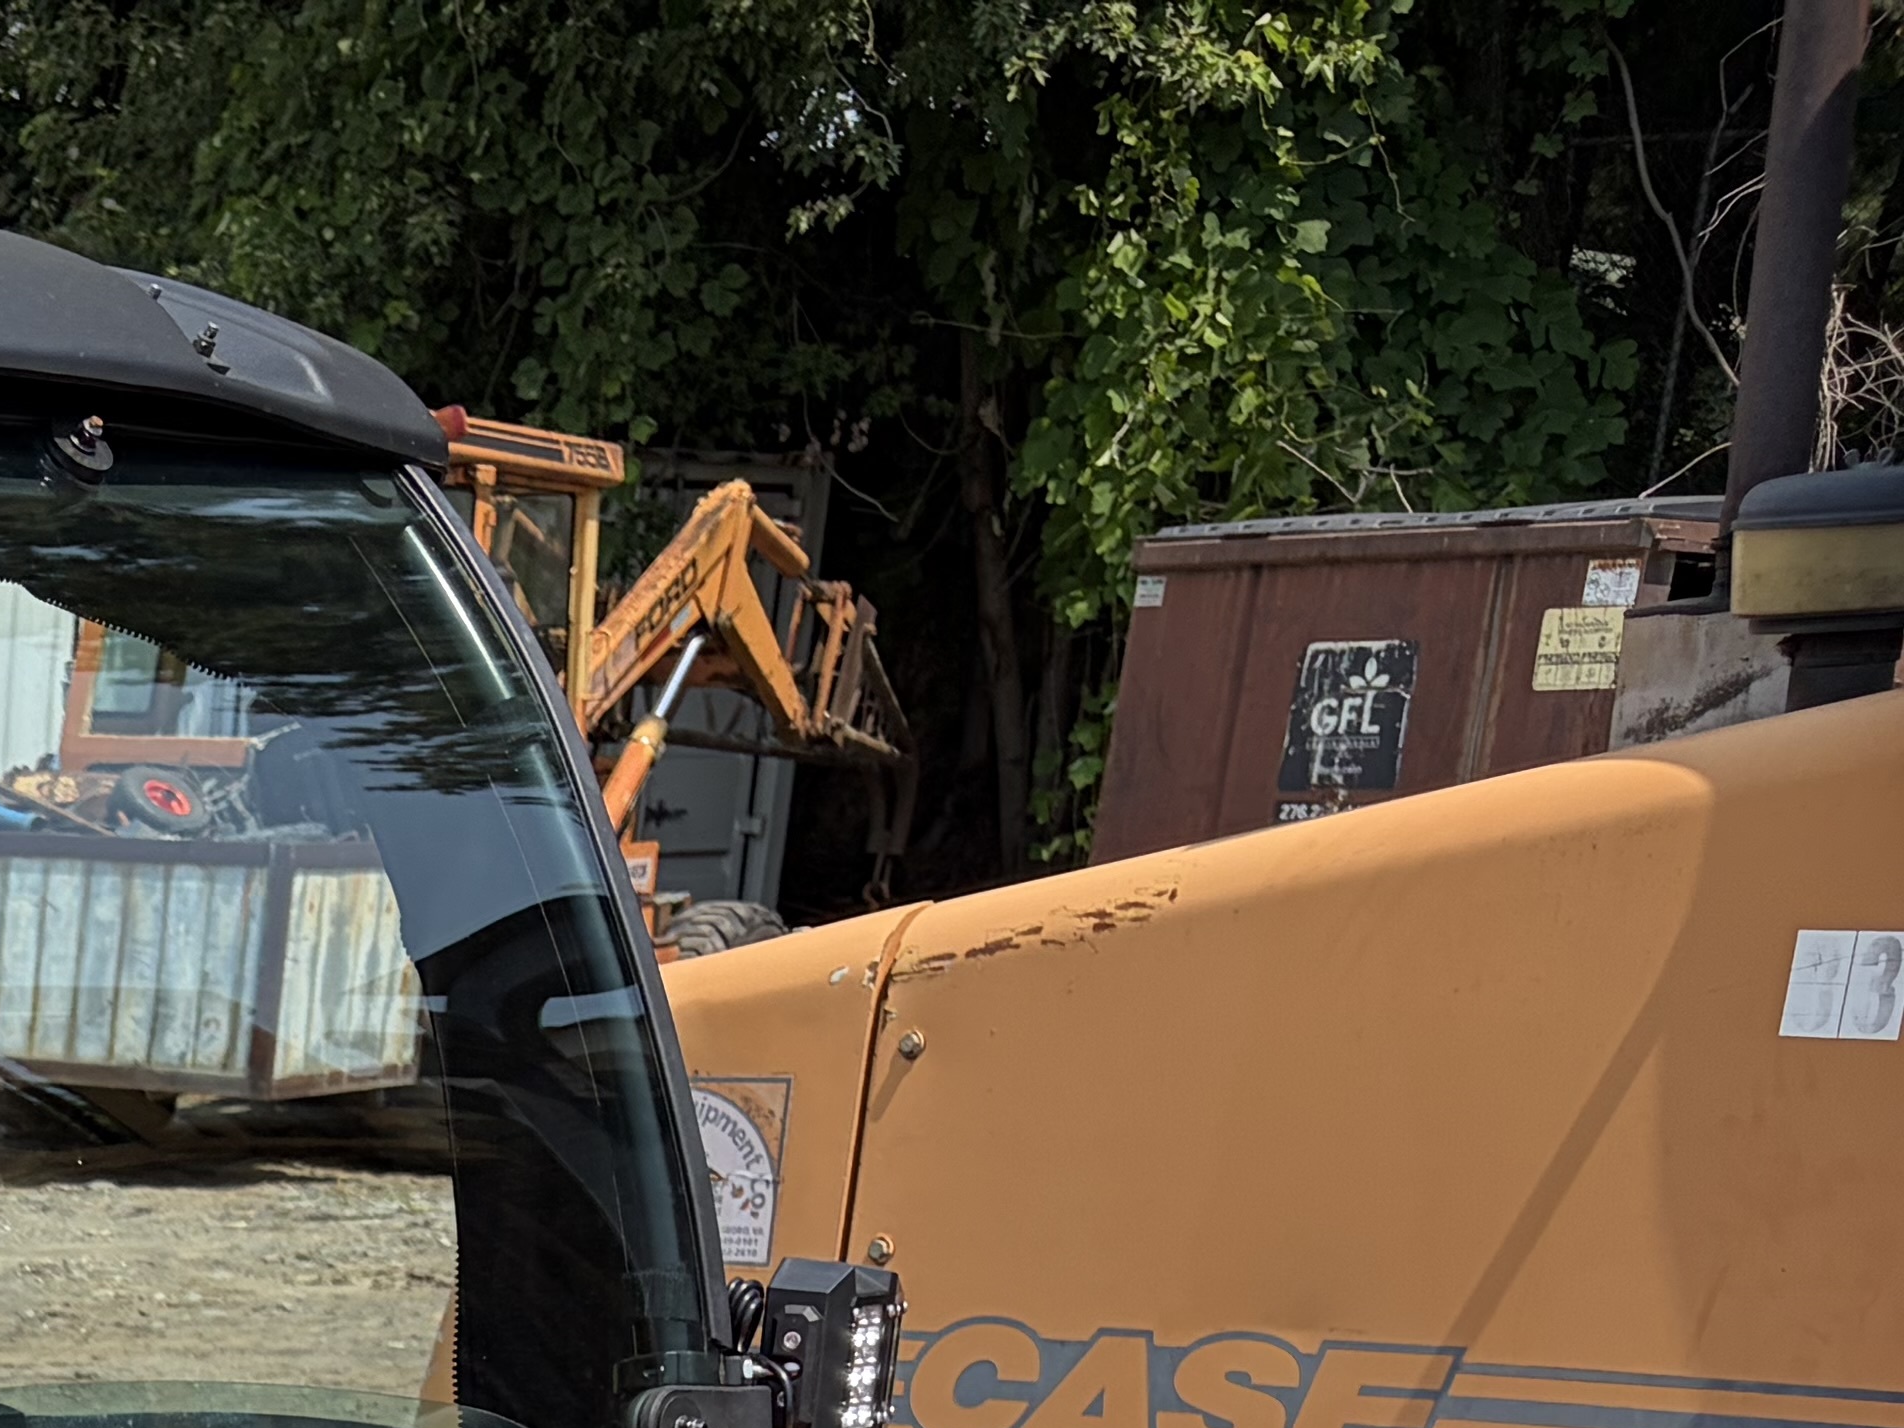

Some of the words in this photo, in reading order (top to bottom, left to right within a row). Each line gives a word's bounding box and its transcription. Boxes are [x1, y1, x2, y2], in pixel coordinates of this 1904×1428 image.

[564, 441, 611, 472] 755B
[634, 556, 698, 651] FORD
[1309, 690, 1381, 736] GFL
